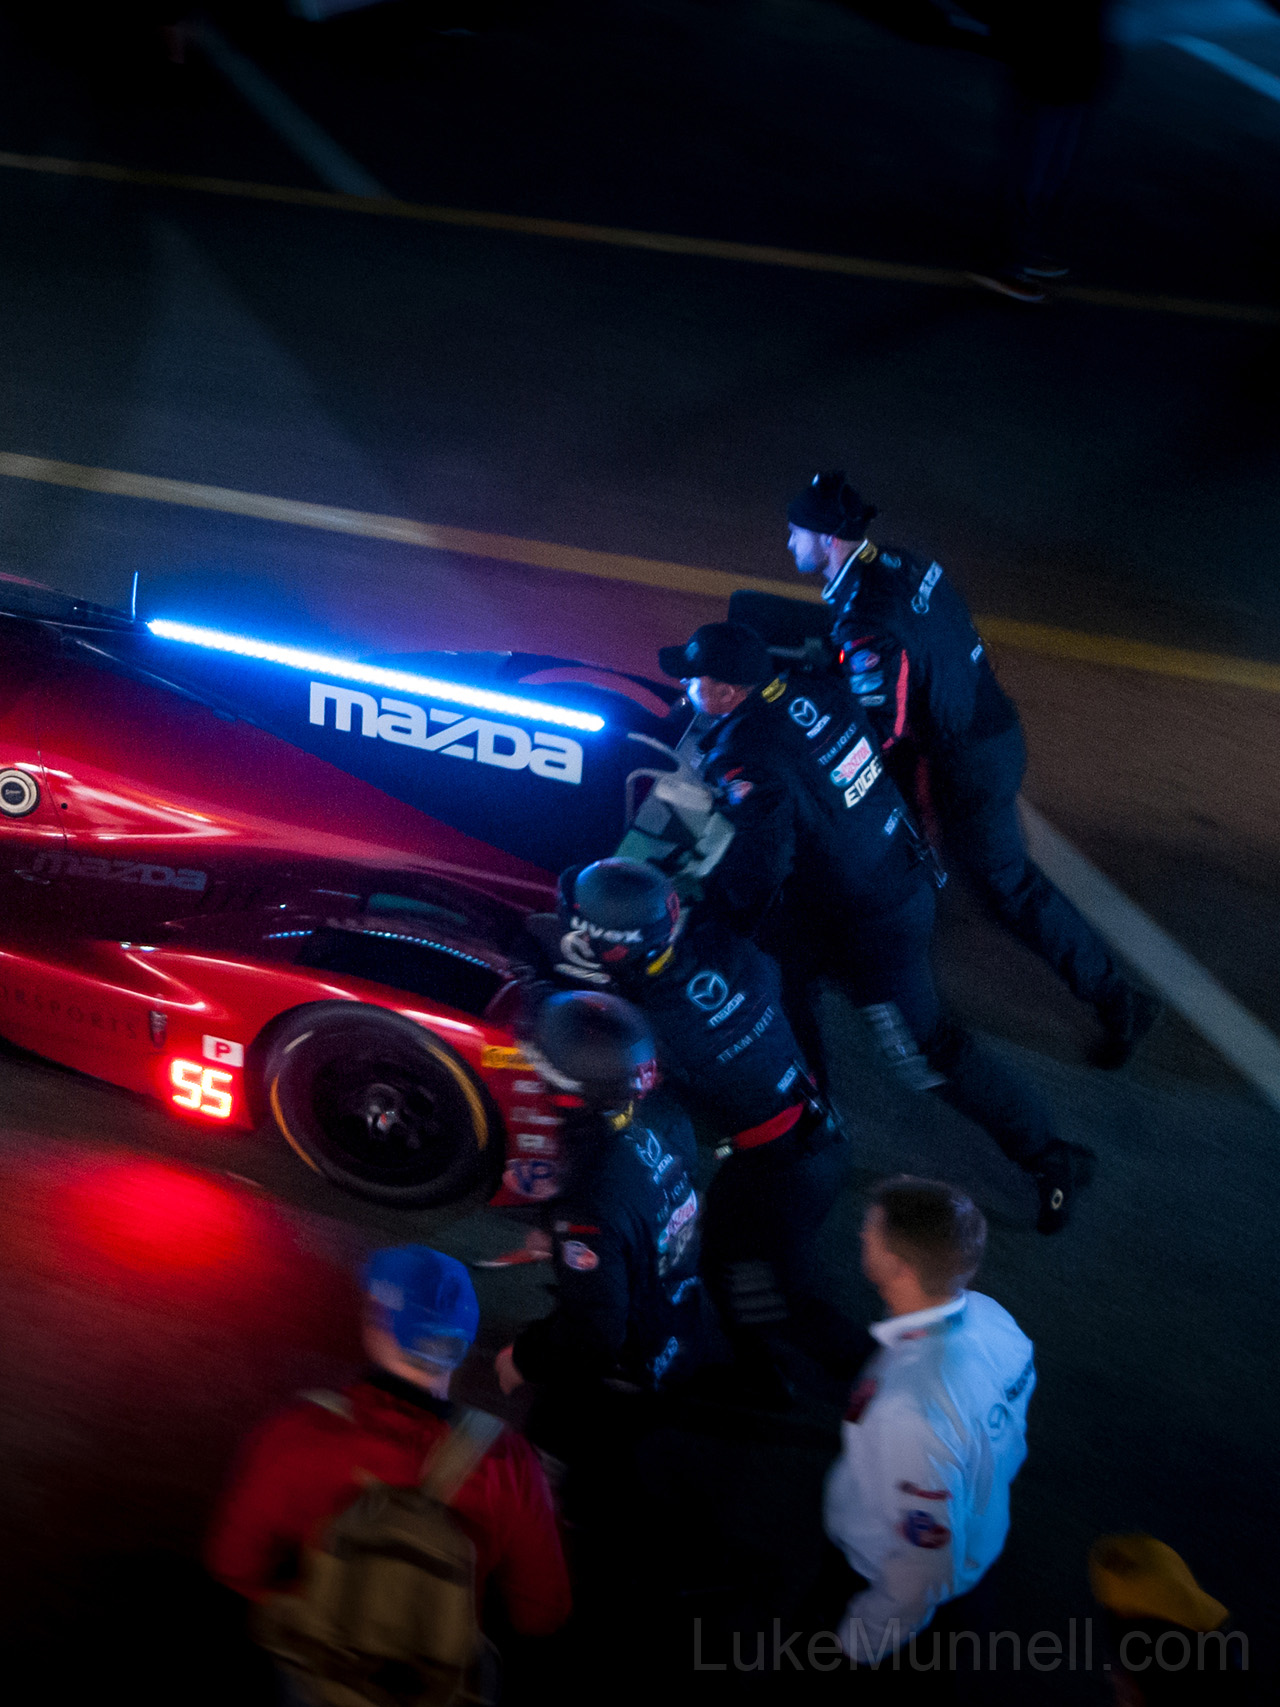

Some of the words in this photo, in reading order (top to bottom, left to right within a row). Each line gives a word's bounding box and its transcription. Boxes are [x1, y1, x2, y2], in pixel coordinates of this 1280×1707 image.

[844, 756, 883, 809] EDGE
[215, 1041, 231, 1058] P
[170, 1057, 233, 1119] 55
